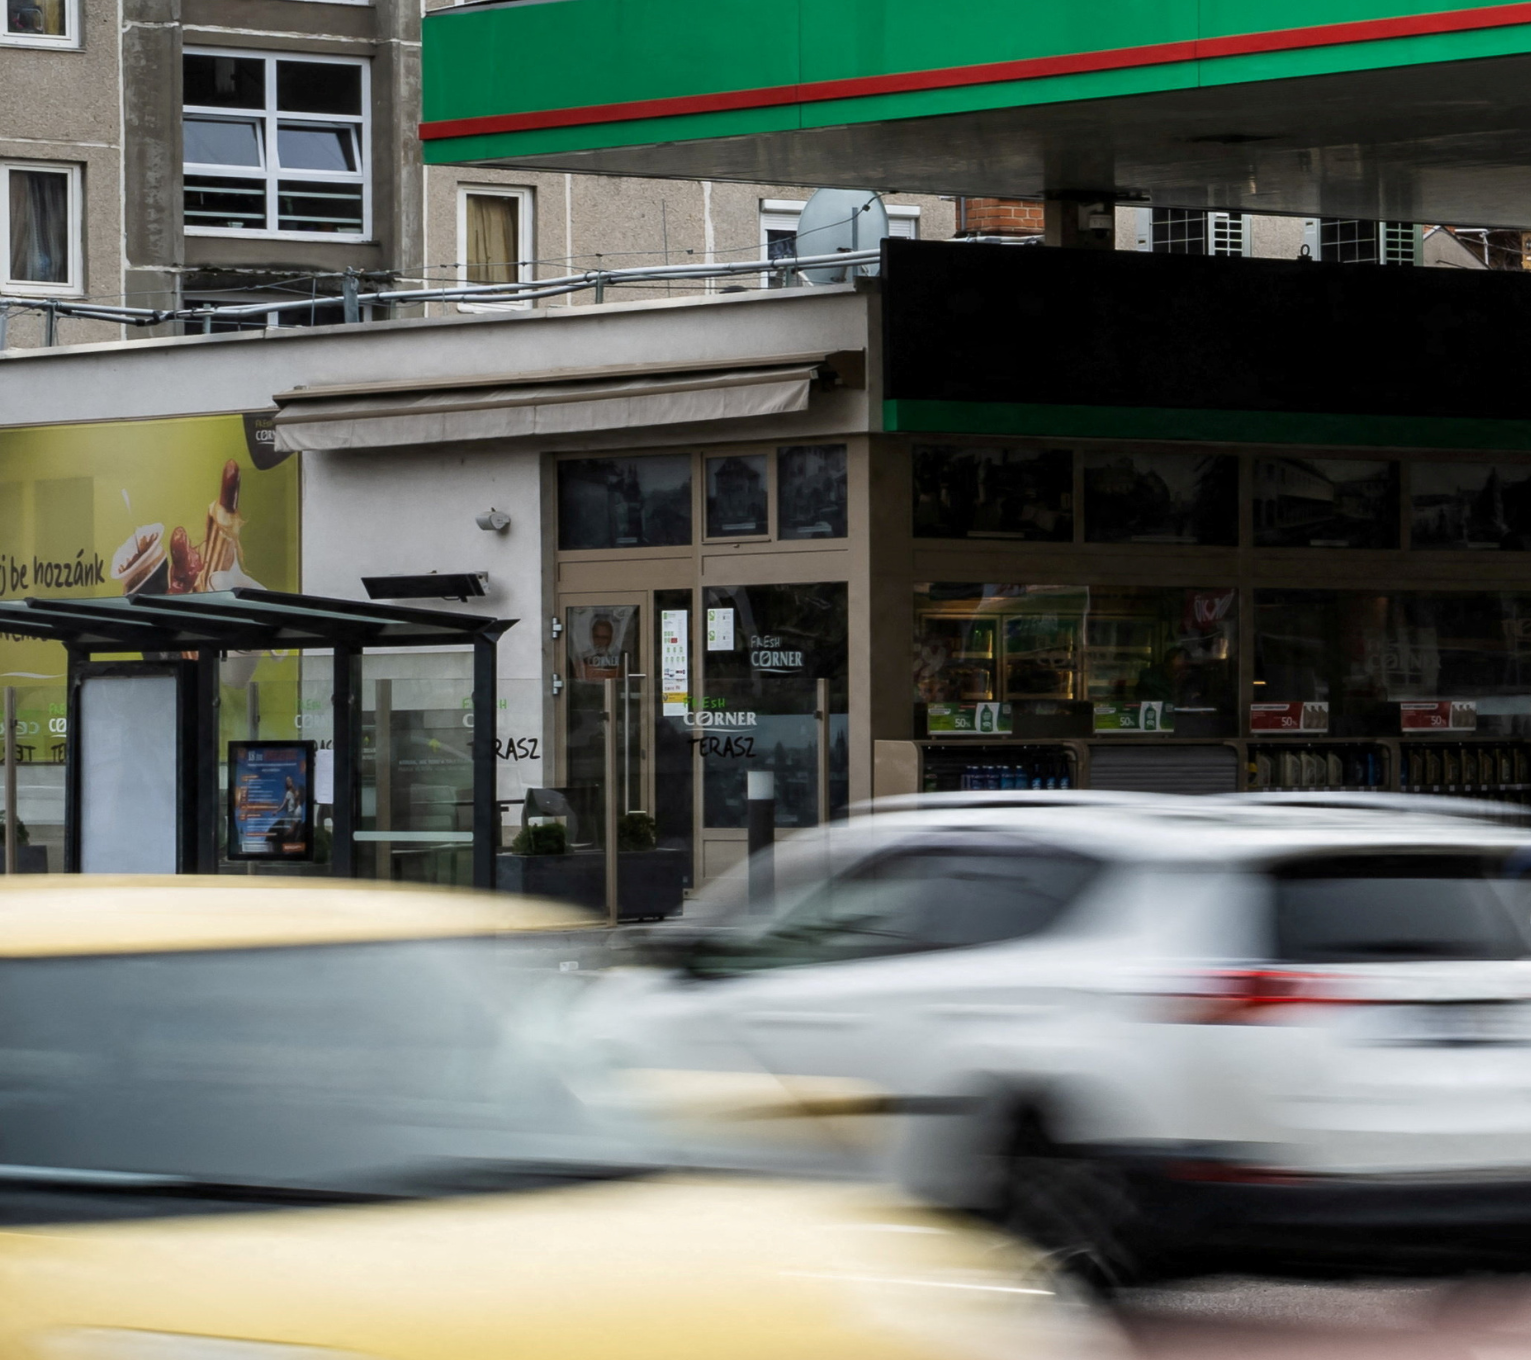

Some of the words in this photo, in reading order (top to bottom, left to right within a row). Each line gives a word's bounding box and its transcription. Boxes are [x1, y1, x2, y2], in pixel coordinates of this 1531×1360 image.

[10, 556, 29, 592] be
[33, 548, 105, 588] hozzánk
[751, 650, 804, 668] CORNER
[683, 711, 757, 727] CORNER
[687, 736, 757, 758] TERASZ
